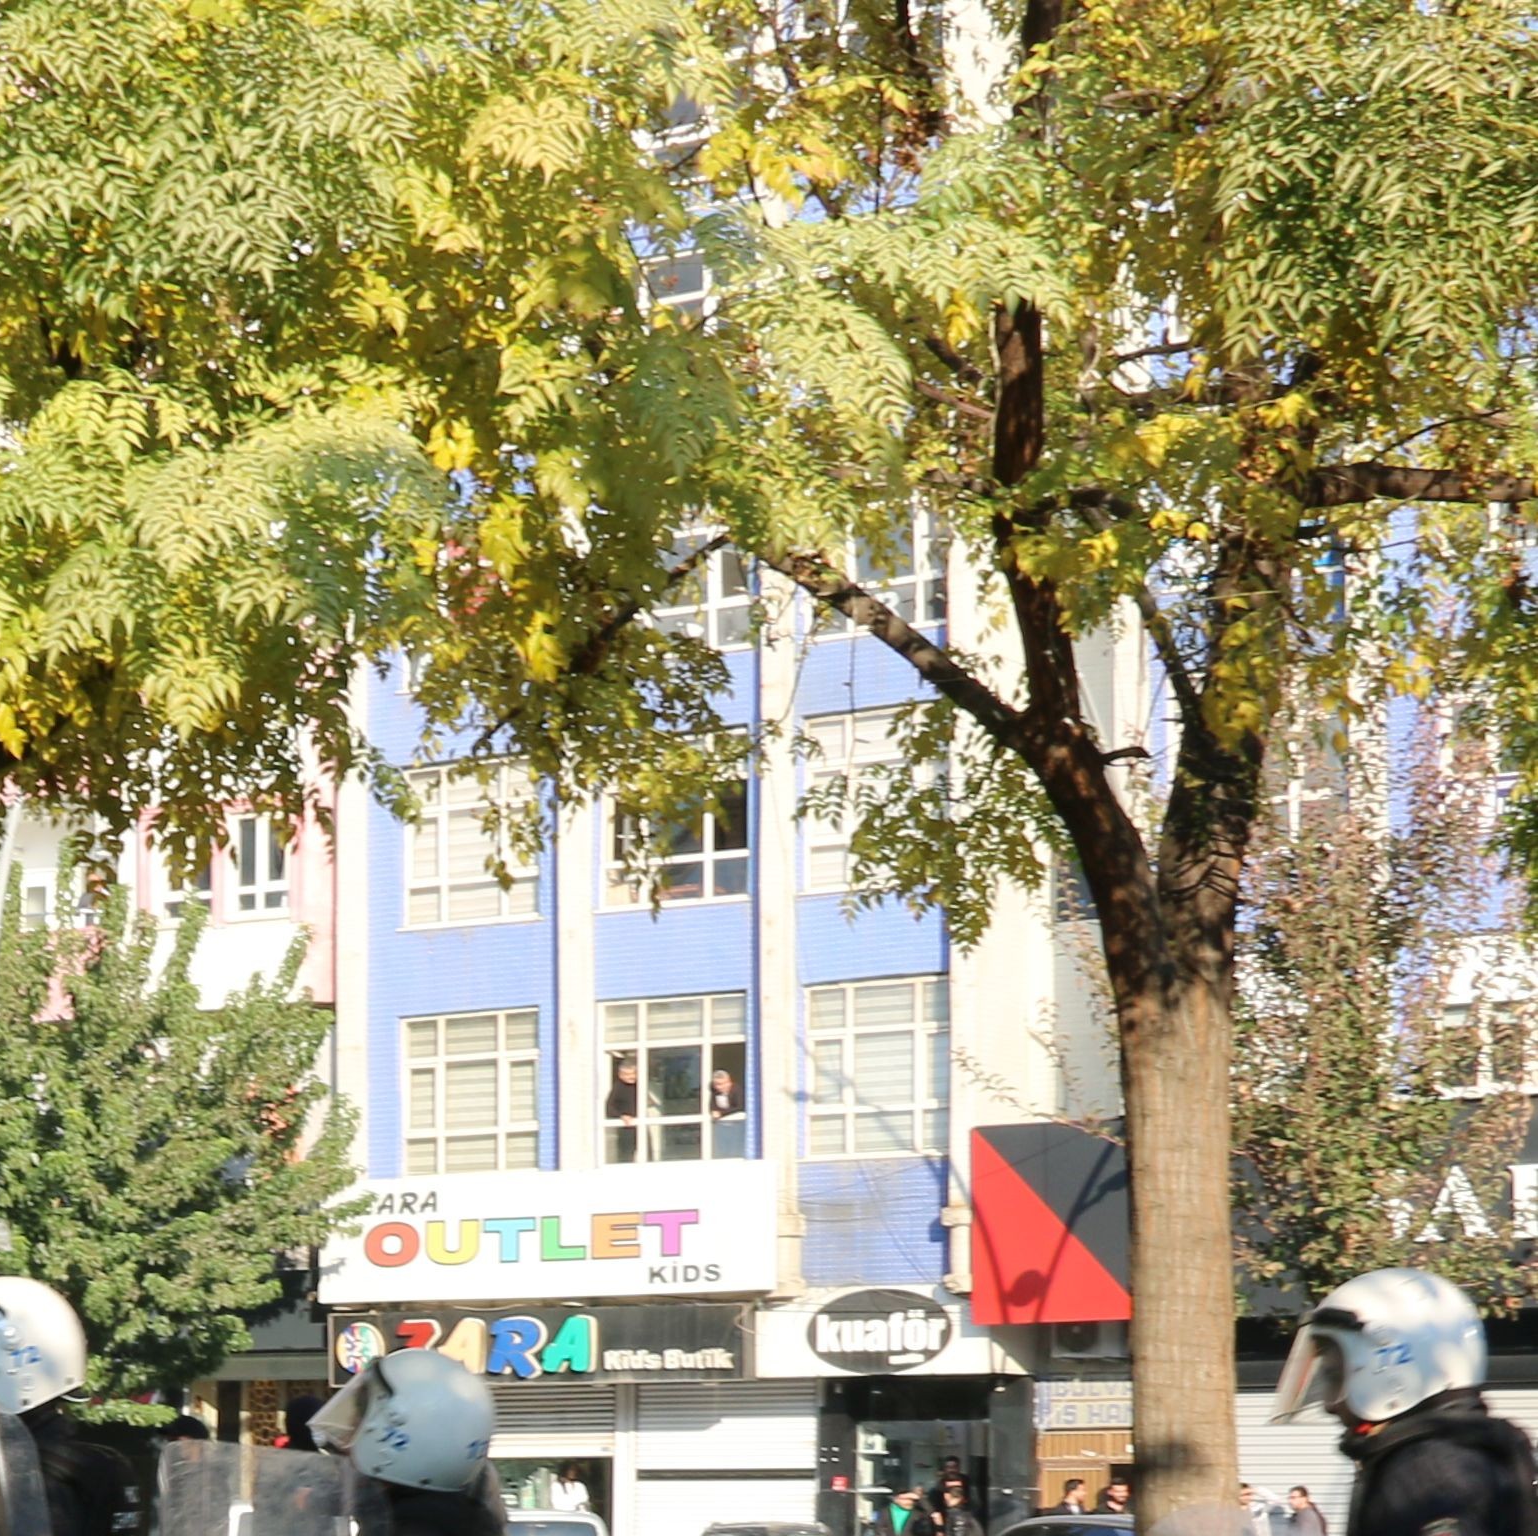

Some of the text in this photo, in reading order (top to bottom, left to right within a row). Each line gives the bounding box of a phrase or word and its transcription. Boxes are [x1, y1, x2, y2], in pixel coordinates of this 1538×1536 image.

[364, 1209, 699, 1267] OUTLET
[816, 1308, 946, 1353] kuaför
[1373, 1343, 1414, 1368] 72
